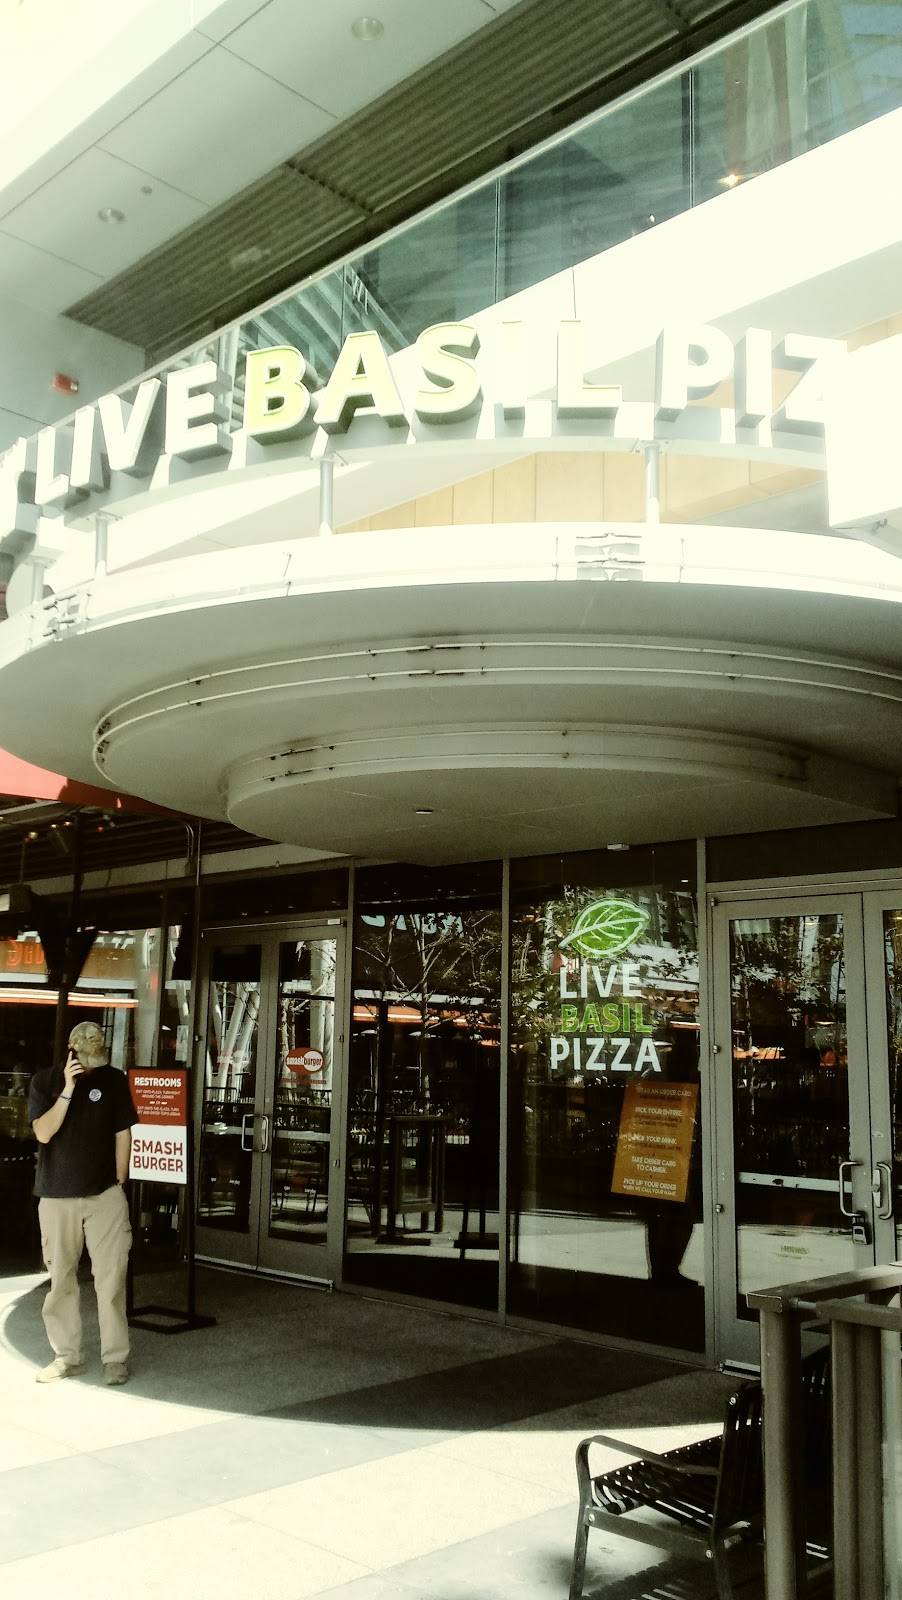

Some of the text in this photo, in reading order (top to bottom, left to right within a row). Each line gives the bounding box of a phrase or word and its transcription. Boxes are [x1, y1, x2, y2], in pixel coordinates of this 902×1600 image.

[35, 361, 225, 505] LIVE
[244, 321, 624, 441] BASIL
[558, 964, 642, 999] LIVE
[560, 1003, 652, 1033] BASIL
[550, 1037, 662, 1073] PIZZA
[134, 1077, 182, 1088] RESTROOMS
[133, 1139, 183, 1156] SMASH
[133, 1155, 184, 1173] BURGER
[644, 1179, 659, 1188] YOUR
